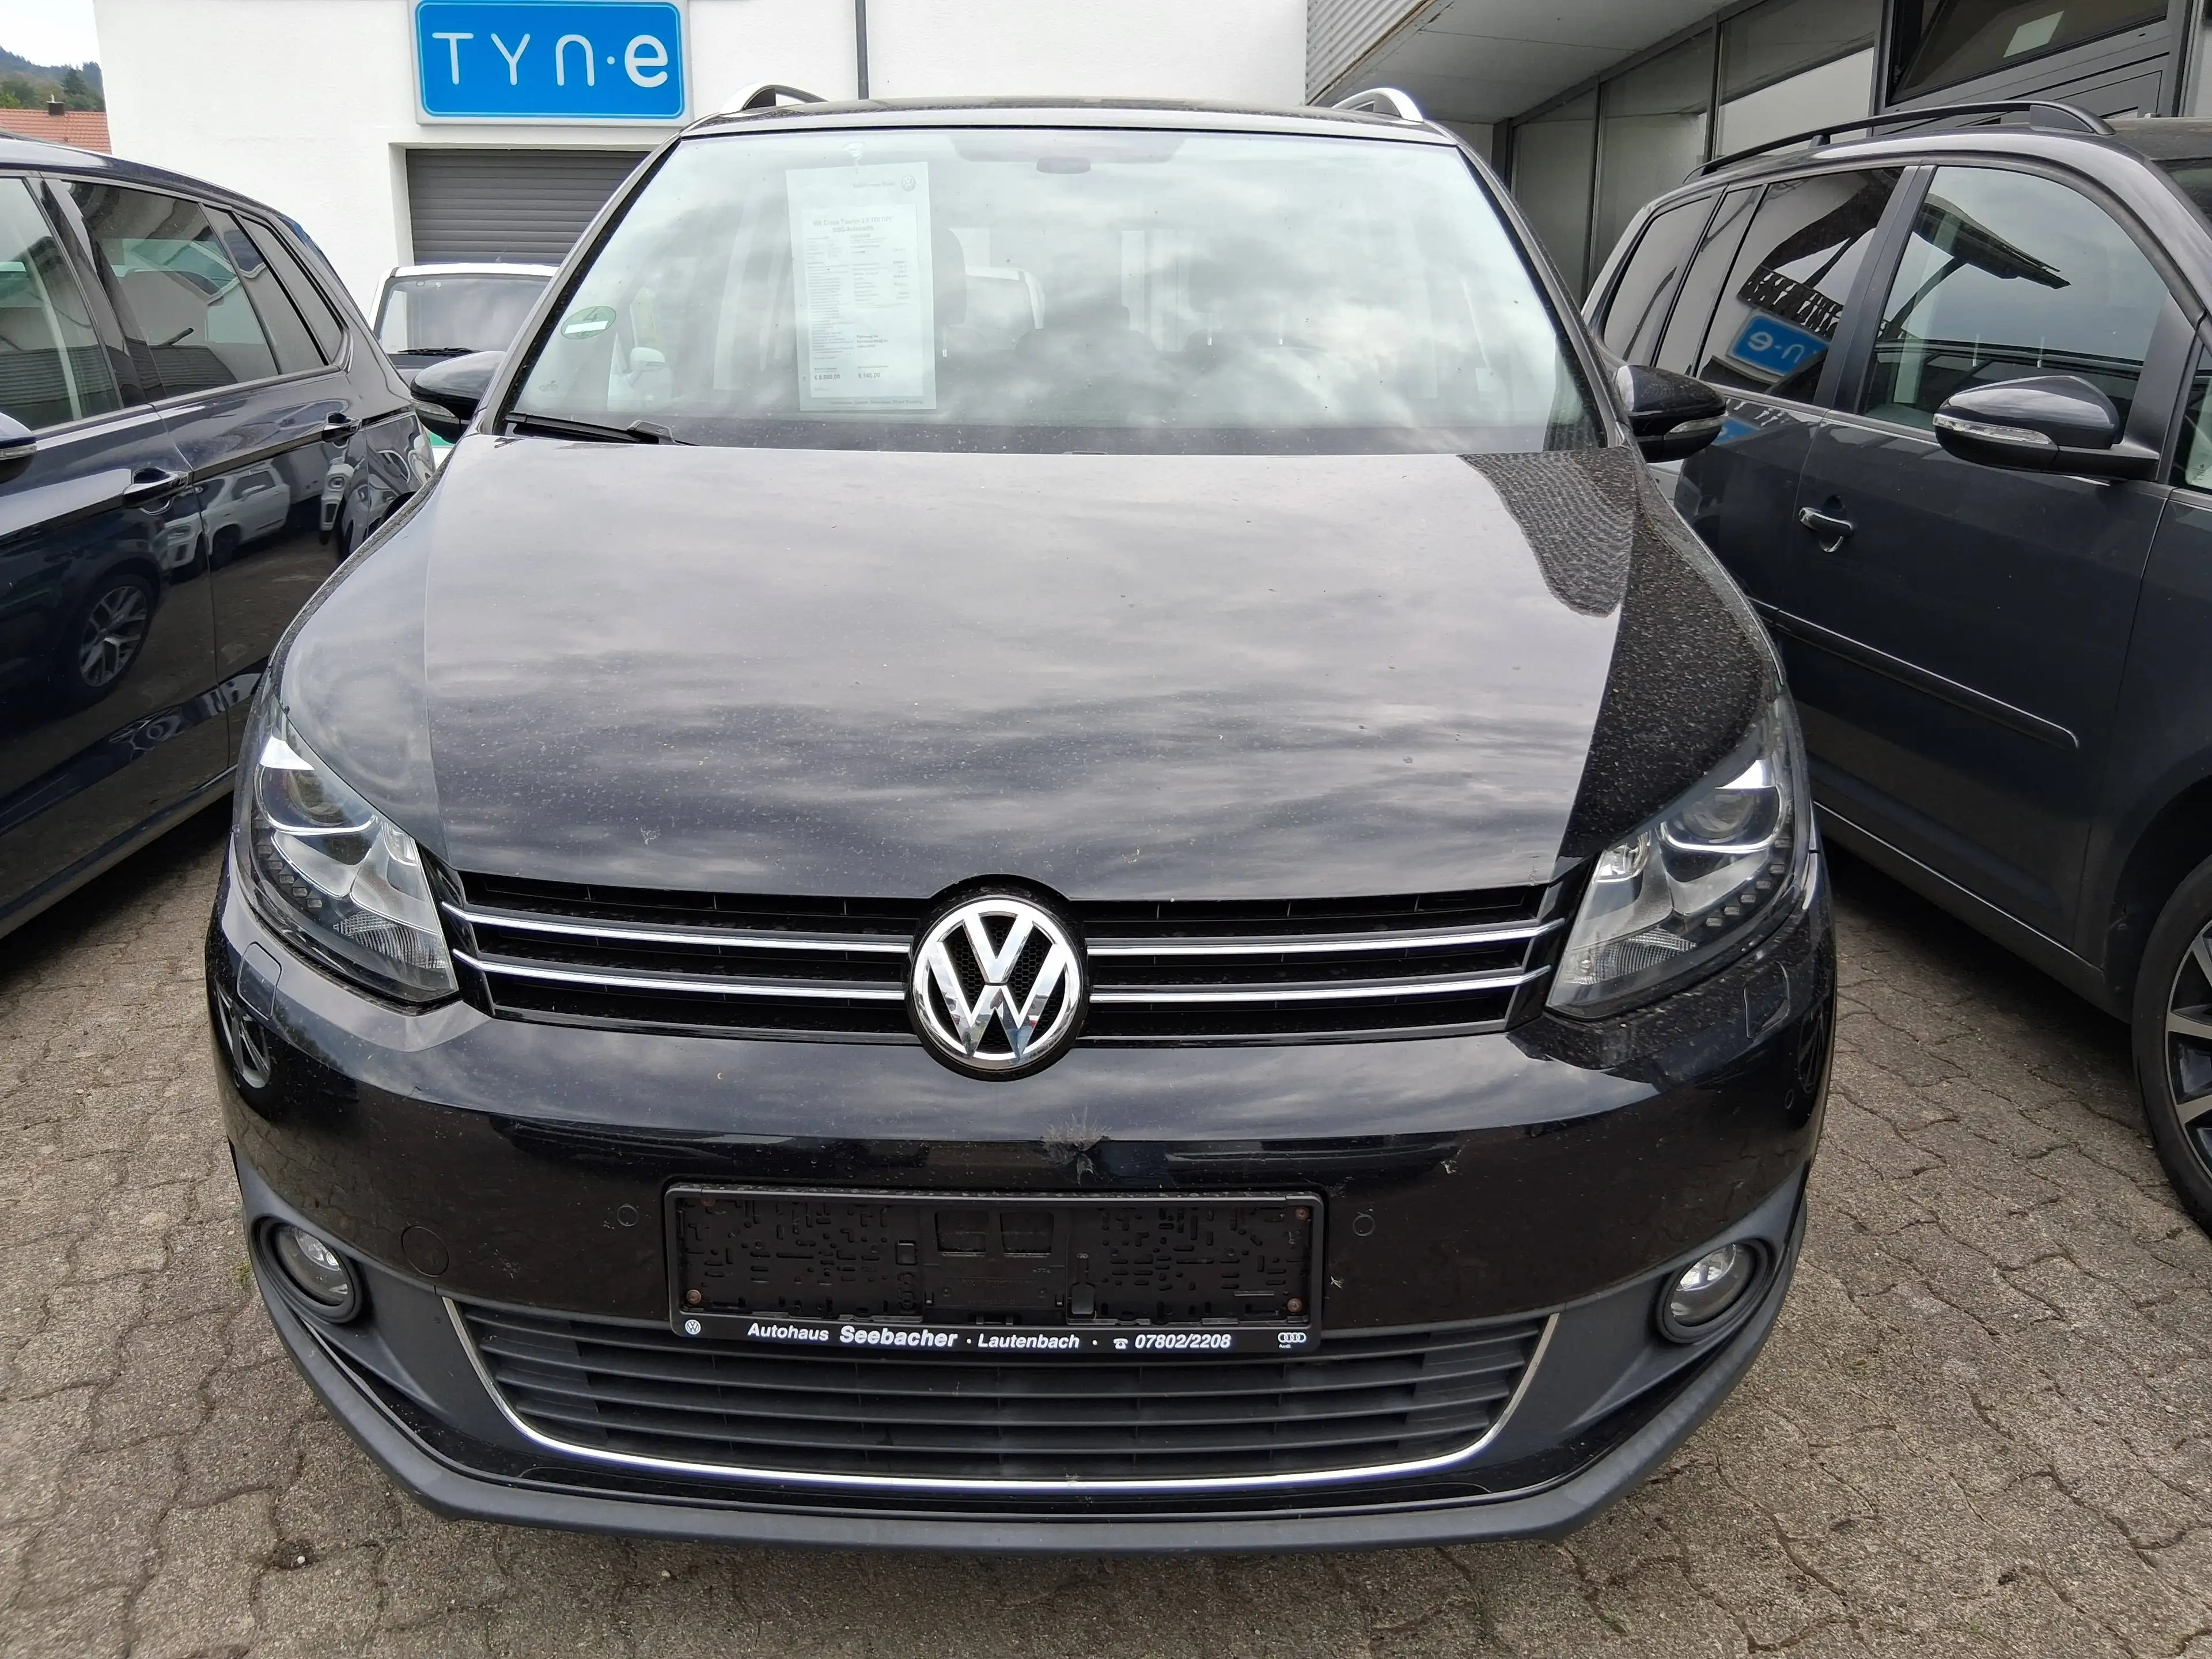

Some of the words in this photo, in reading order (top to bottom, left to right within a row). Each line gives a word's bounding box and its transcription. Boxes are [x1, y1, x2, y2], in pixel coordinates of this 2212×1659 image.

[747, 1323, 830, 1342] Autohaus
[839, 1325, 958, 1347] Seebacher
[978, 1334, 1080, 1349] Lautenbach
[1134, 1334, 1232, 1349] 07802/2208
